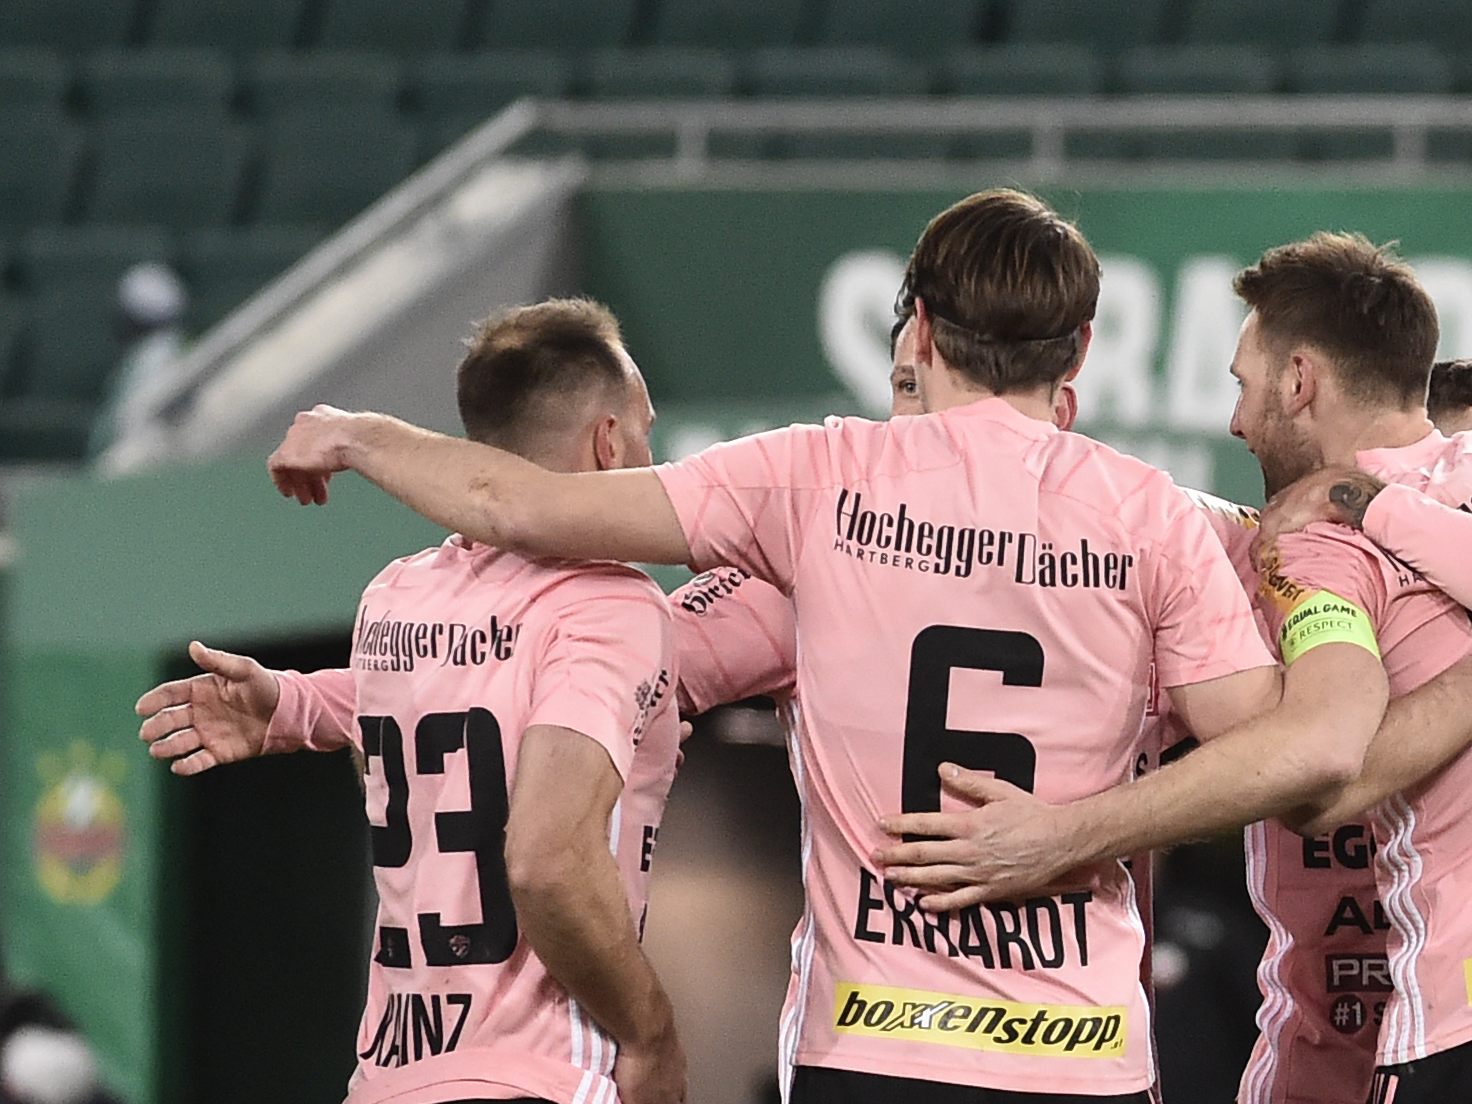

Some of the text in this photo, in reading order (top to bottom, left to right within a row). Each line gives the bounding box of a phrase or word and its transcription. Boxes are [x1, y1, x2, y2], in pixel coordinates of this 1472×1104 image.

[833, 537, 931, 572] HARTBERG
[1322, 603, 1358, 618] GAME
[1299, 619, 1353, 641] RESPECT
[901, 624, 1045, 842] 6
